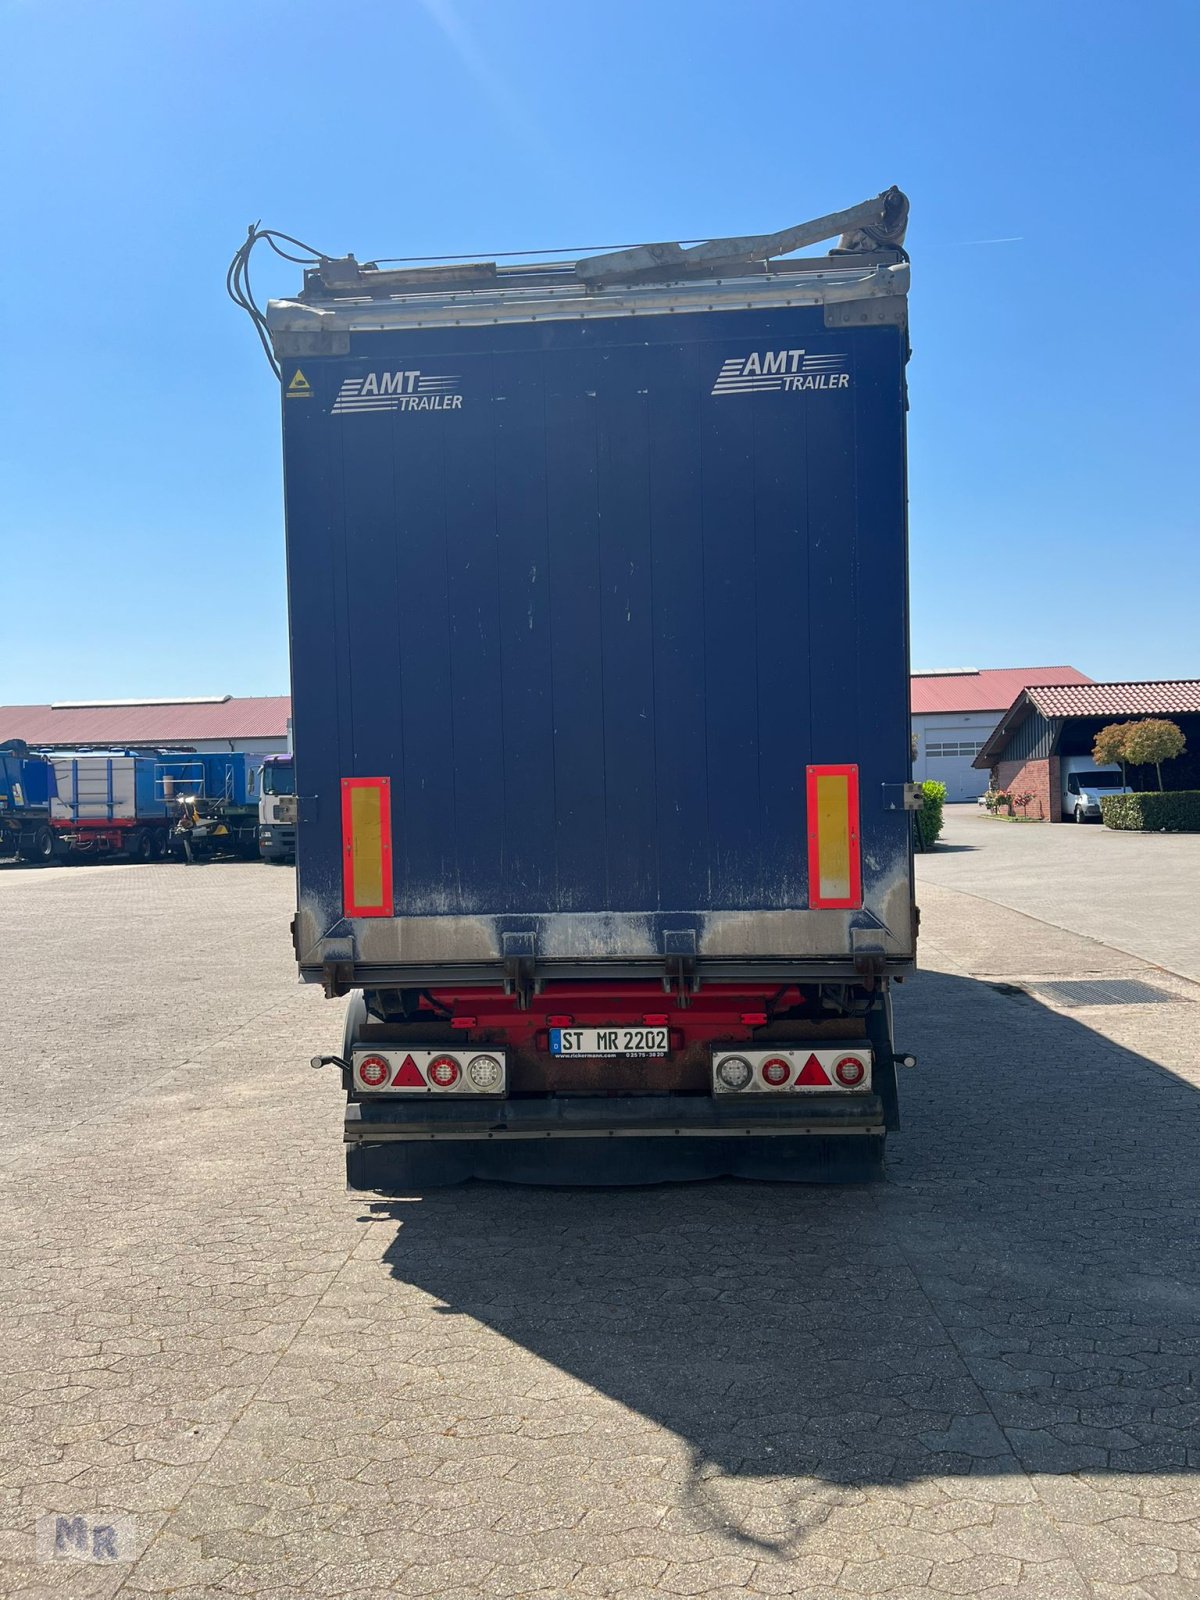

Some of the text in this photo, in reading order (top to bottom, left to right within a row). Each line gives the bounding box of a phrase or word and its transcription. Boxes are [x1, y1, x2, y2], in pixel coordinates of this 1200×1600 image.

[742, 350, 805, 375] AMT
[361, 370, 420, 395] AMT
[783, 374, 849, 391] TRAILER
[400, 395, 463, 411] TRAILER
[562, 1031, 666, 1050] ST MR 2202
